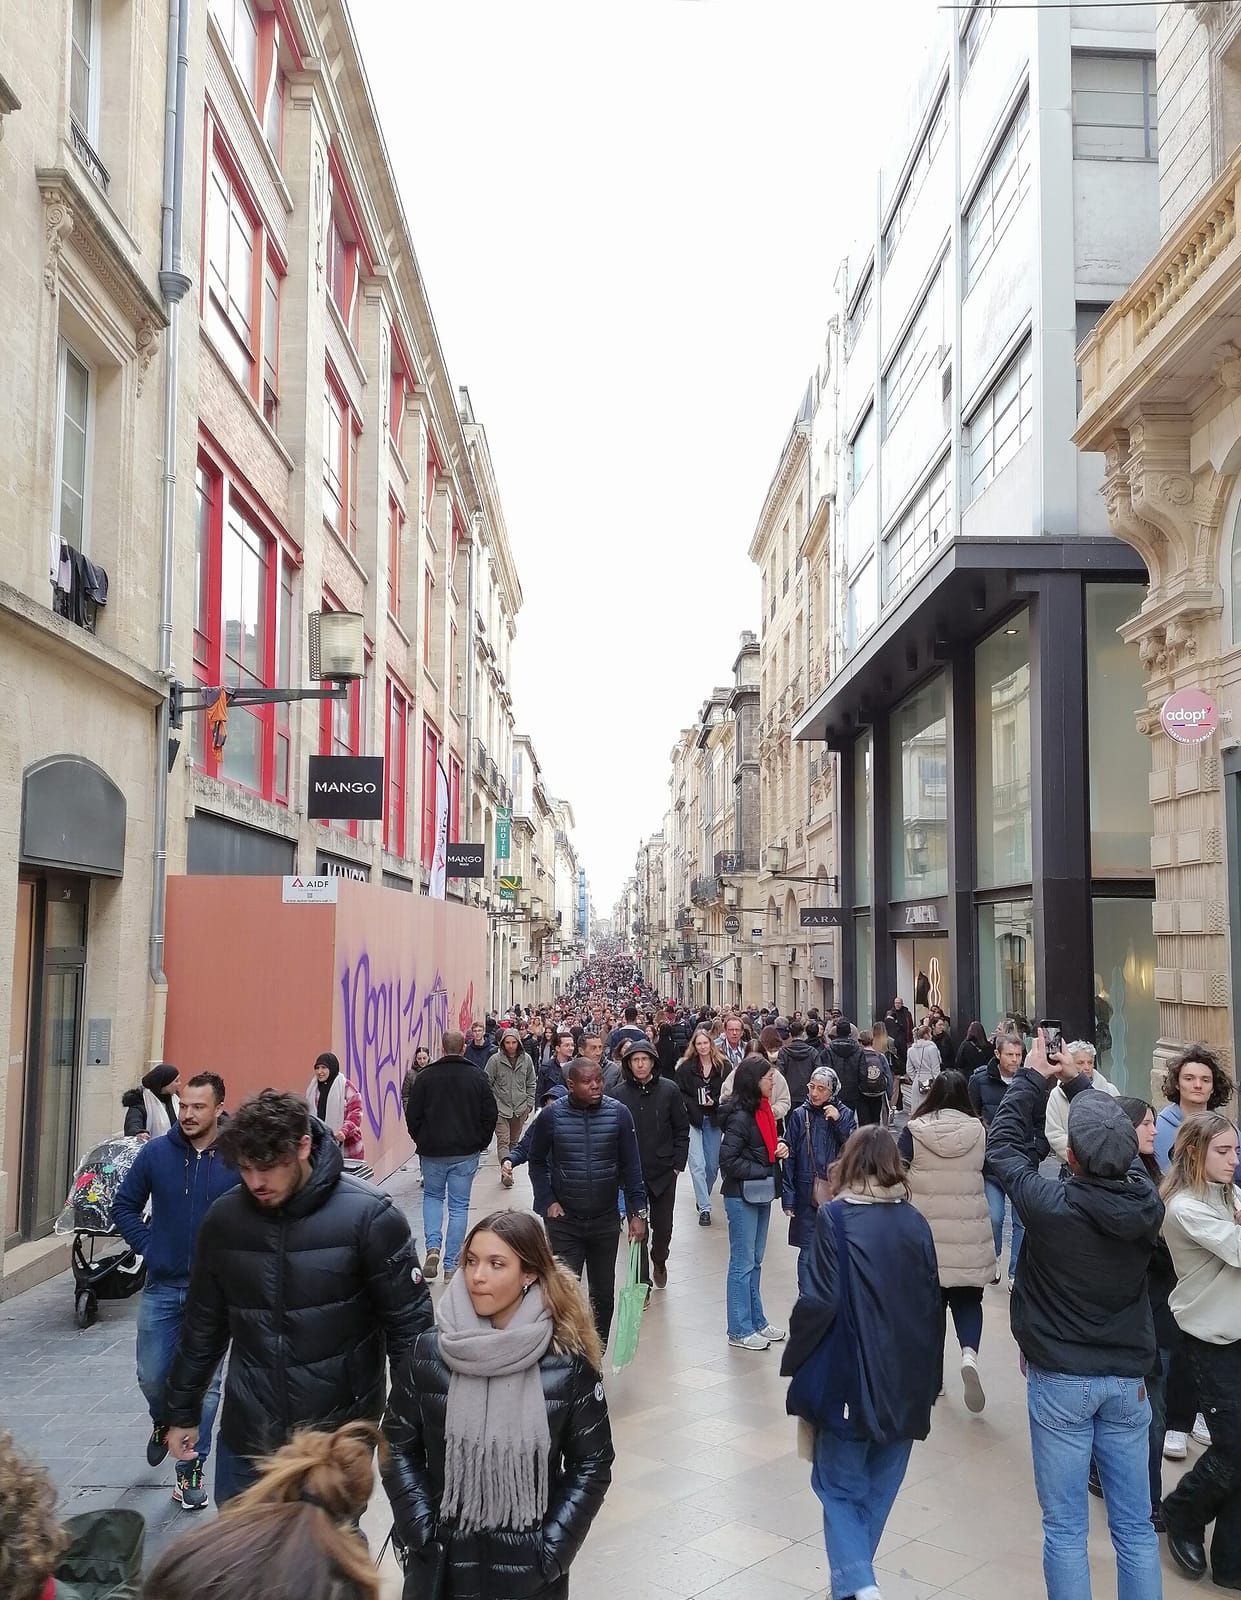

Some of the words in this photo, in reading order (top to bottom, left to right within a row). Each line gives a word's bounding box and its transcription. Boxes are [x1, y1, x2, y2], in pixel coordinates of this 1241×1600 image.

[1166, 708, 1206, 724] adopt
[315, 782, 376, 794] MANGO
[447, 855, 482, 863] MANGO
